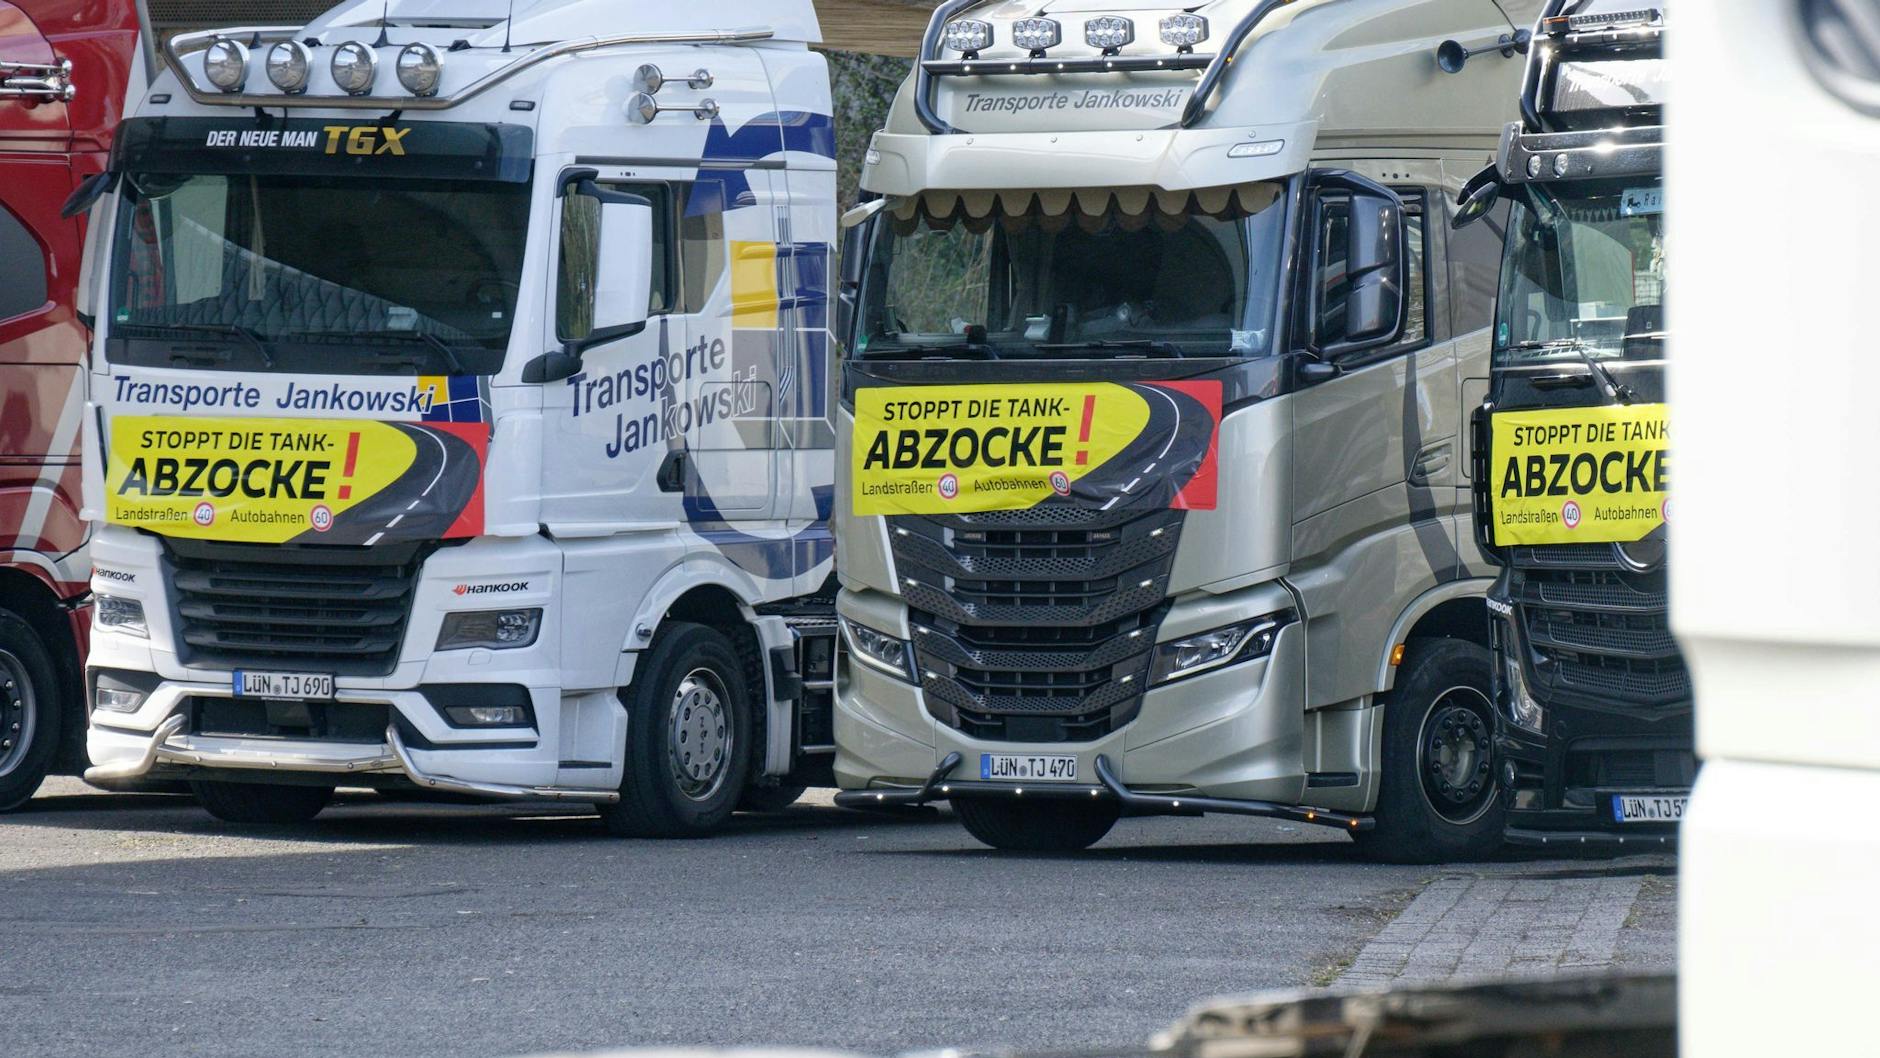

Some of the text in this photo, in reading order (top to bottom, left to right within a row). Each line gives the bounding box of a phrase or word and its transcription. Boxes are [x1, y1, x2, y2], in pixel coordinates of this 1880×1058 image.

[965, 89, 1183, 114] Transporte Jankowski
[206, 126, 412, 155] DER NEUE MAN TGX
[566, 335, 726, 417] Transporte
[114, 375, 438, 413] Transporte Jankowski
[606, 365, 757, 459] Jankowski
[883, 398, 1070, 421] STOPPT DIE TANK-
[141, 431, 334, 452] STOPPT DIE TANK-
[1514, 424, 1582, 446] STOPPT
[1587, 422, 1616, 442] DIE
[862, 481, 932, 496] Landstraßen
[974, 478, 1047, 492] Autobahnen
[115, 507, 188, 522] Landstraßen
[230, 509, 305, 524] Autobahnen
[1501, 508, 1559, 525] Landstraßen
[1594, 505, 1658, 522] Autobahnen
[303, 677, 330, 695] 690
[1050, 759, 1075, 777] 470
